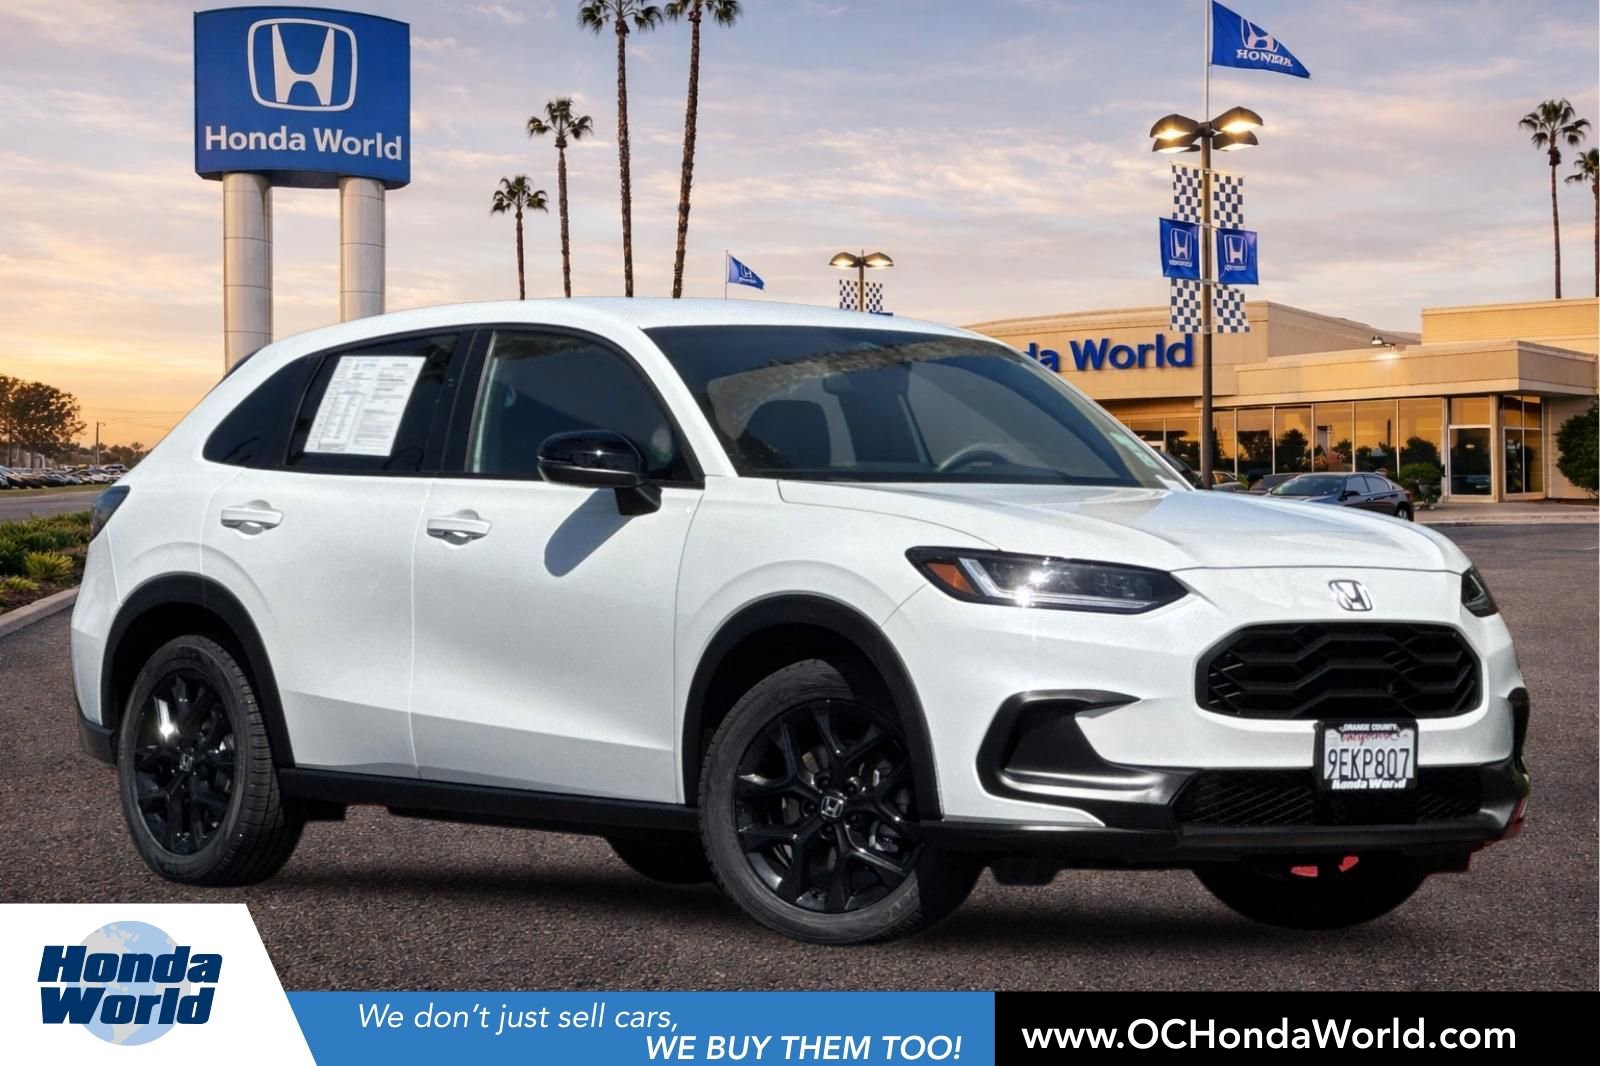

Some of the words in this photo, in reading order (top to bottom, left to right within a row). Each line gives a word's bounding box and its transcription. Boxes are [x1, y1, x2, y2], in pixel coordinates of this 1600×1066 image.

[205, 126, 306, 151] Honda
[313, 127, 402, 160] World
[1069, 334, 1193, 371] World
[1328, 748, 1409, 780] 9EKP807
[1331, 779, 1367, 790] Honda
